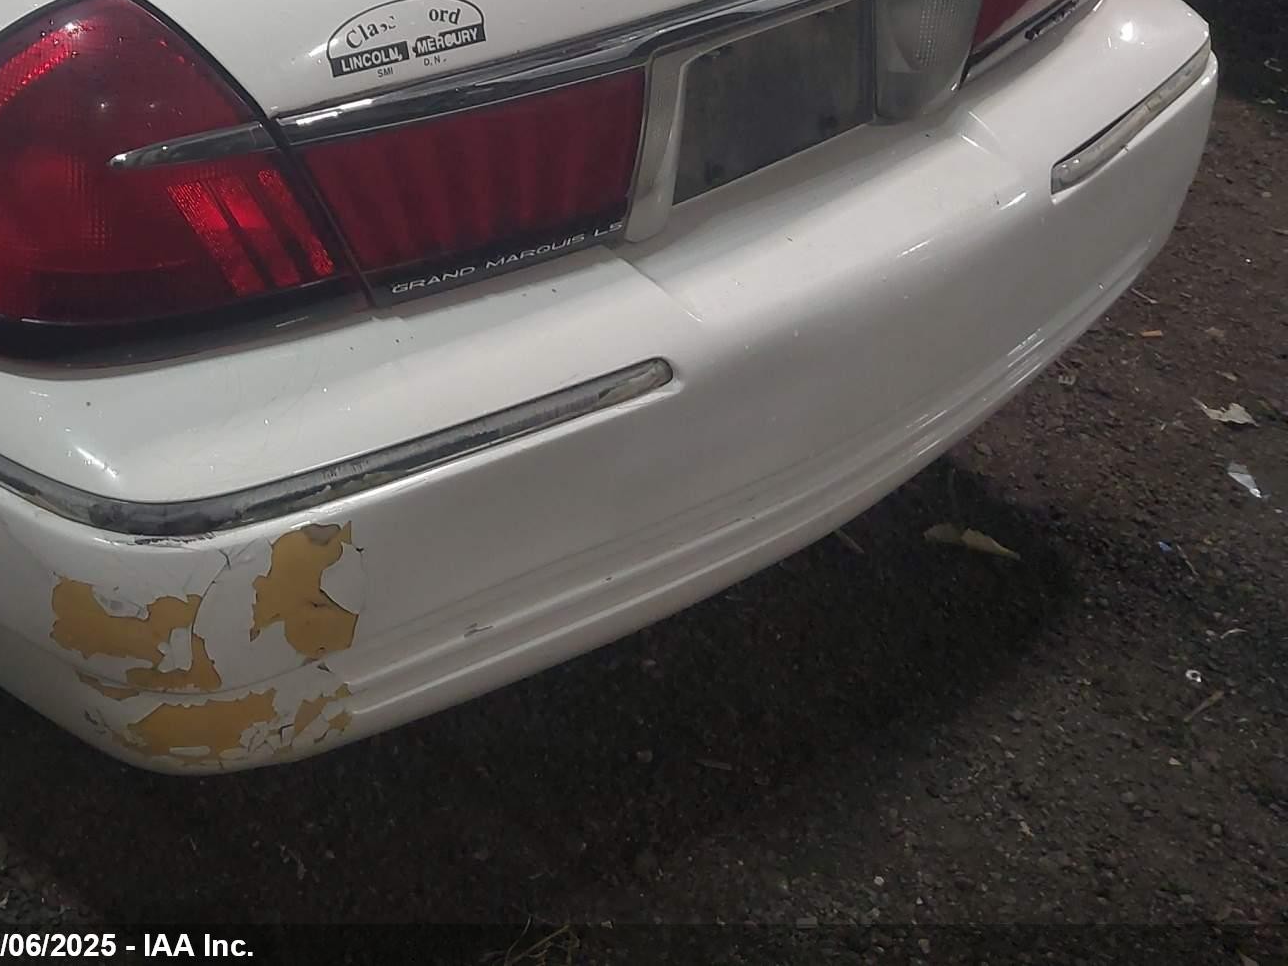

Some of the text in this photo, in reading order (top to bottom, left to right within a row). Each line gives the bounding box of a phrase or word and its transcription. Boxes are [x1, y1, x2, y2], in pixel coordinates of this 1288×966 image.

[429, 8, 461, 25] ord
[416, 28, 478, 54] MERCURY
[392, 221, 623, 294] GRAND MARQUIS LS
